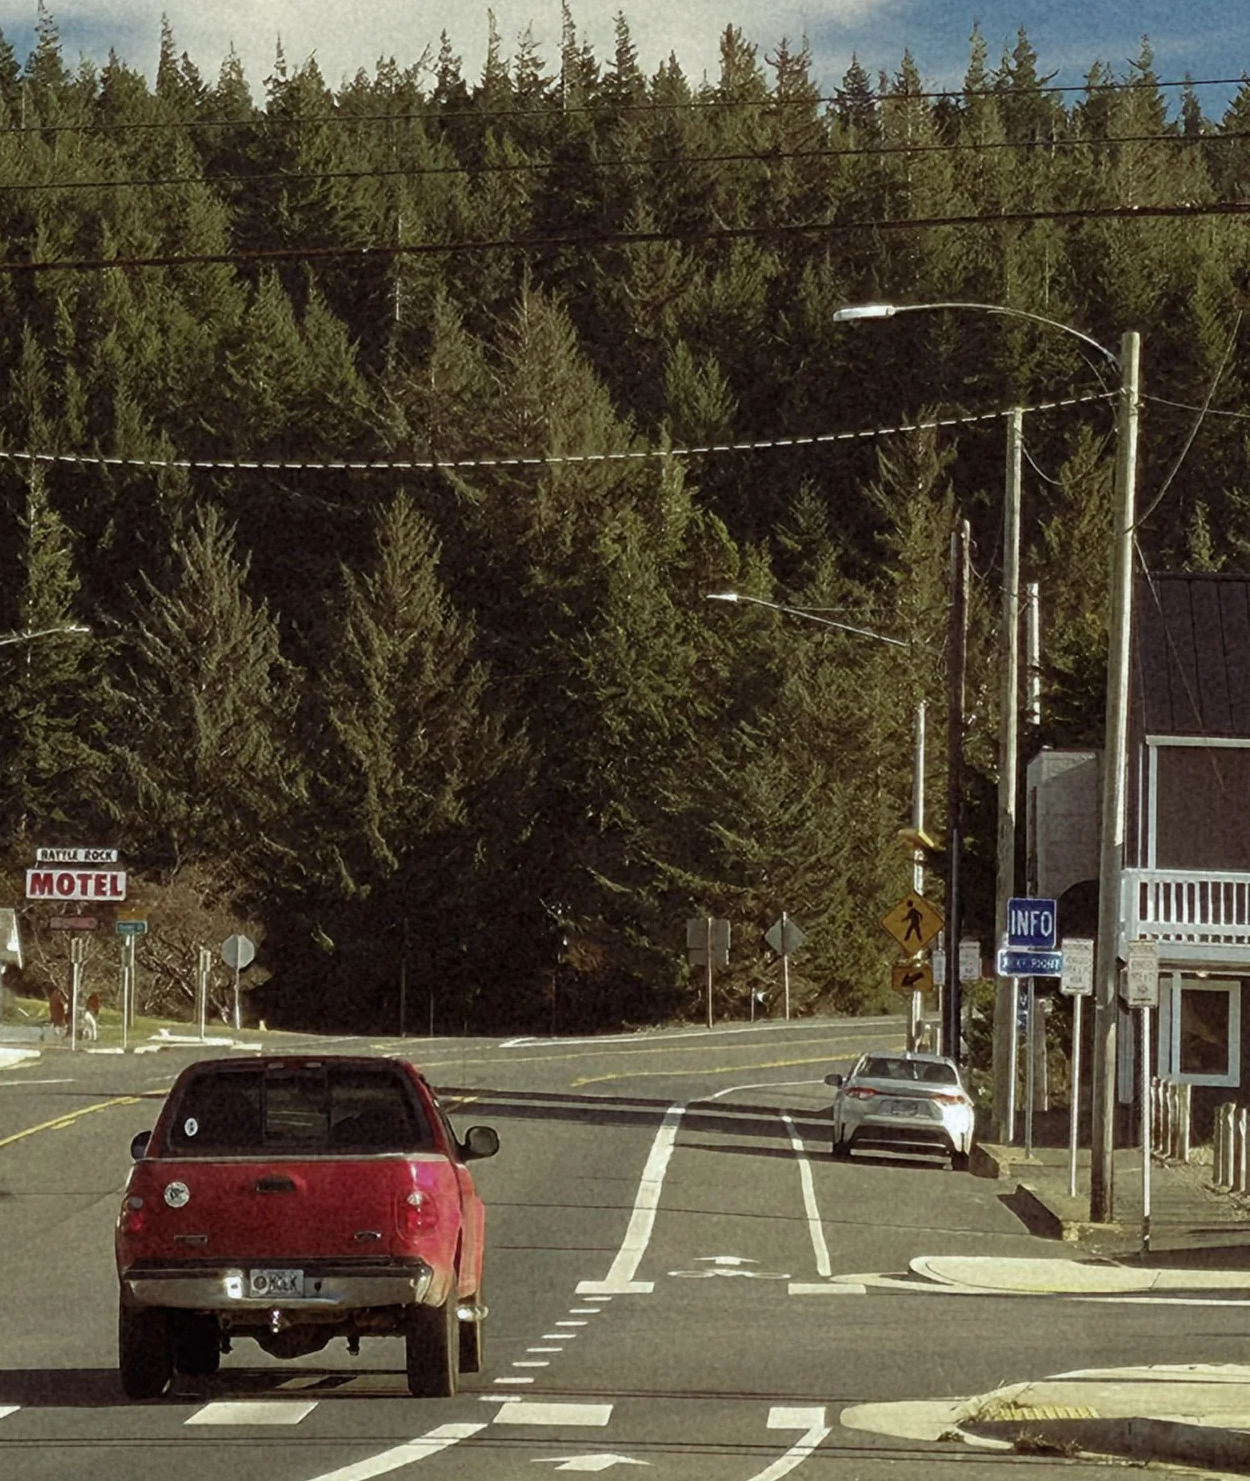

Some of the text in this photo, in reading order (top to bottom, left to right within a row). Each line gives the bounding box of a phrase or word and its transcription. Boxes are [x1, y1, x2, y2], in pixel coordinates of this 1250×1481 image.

[84, 850, 113, 860] ROCK
[30, 872, 124, 897] MOTEL
[1011, 909, 1054, 938] INFO
